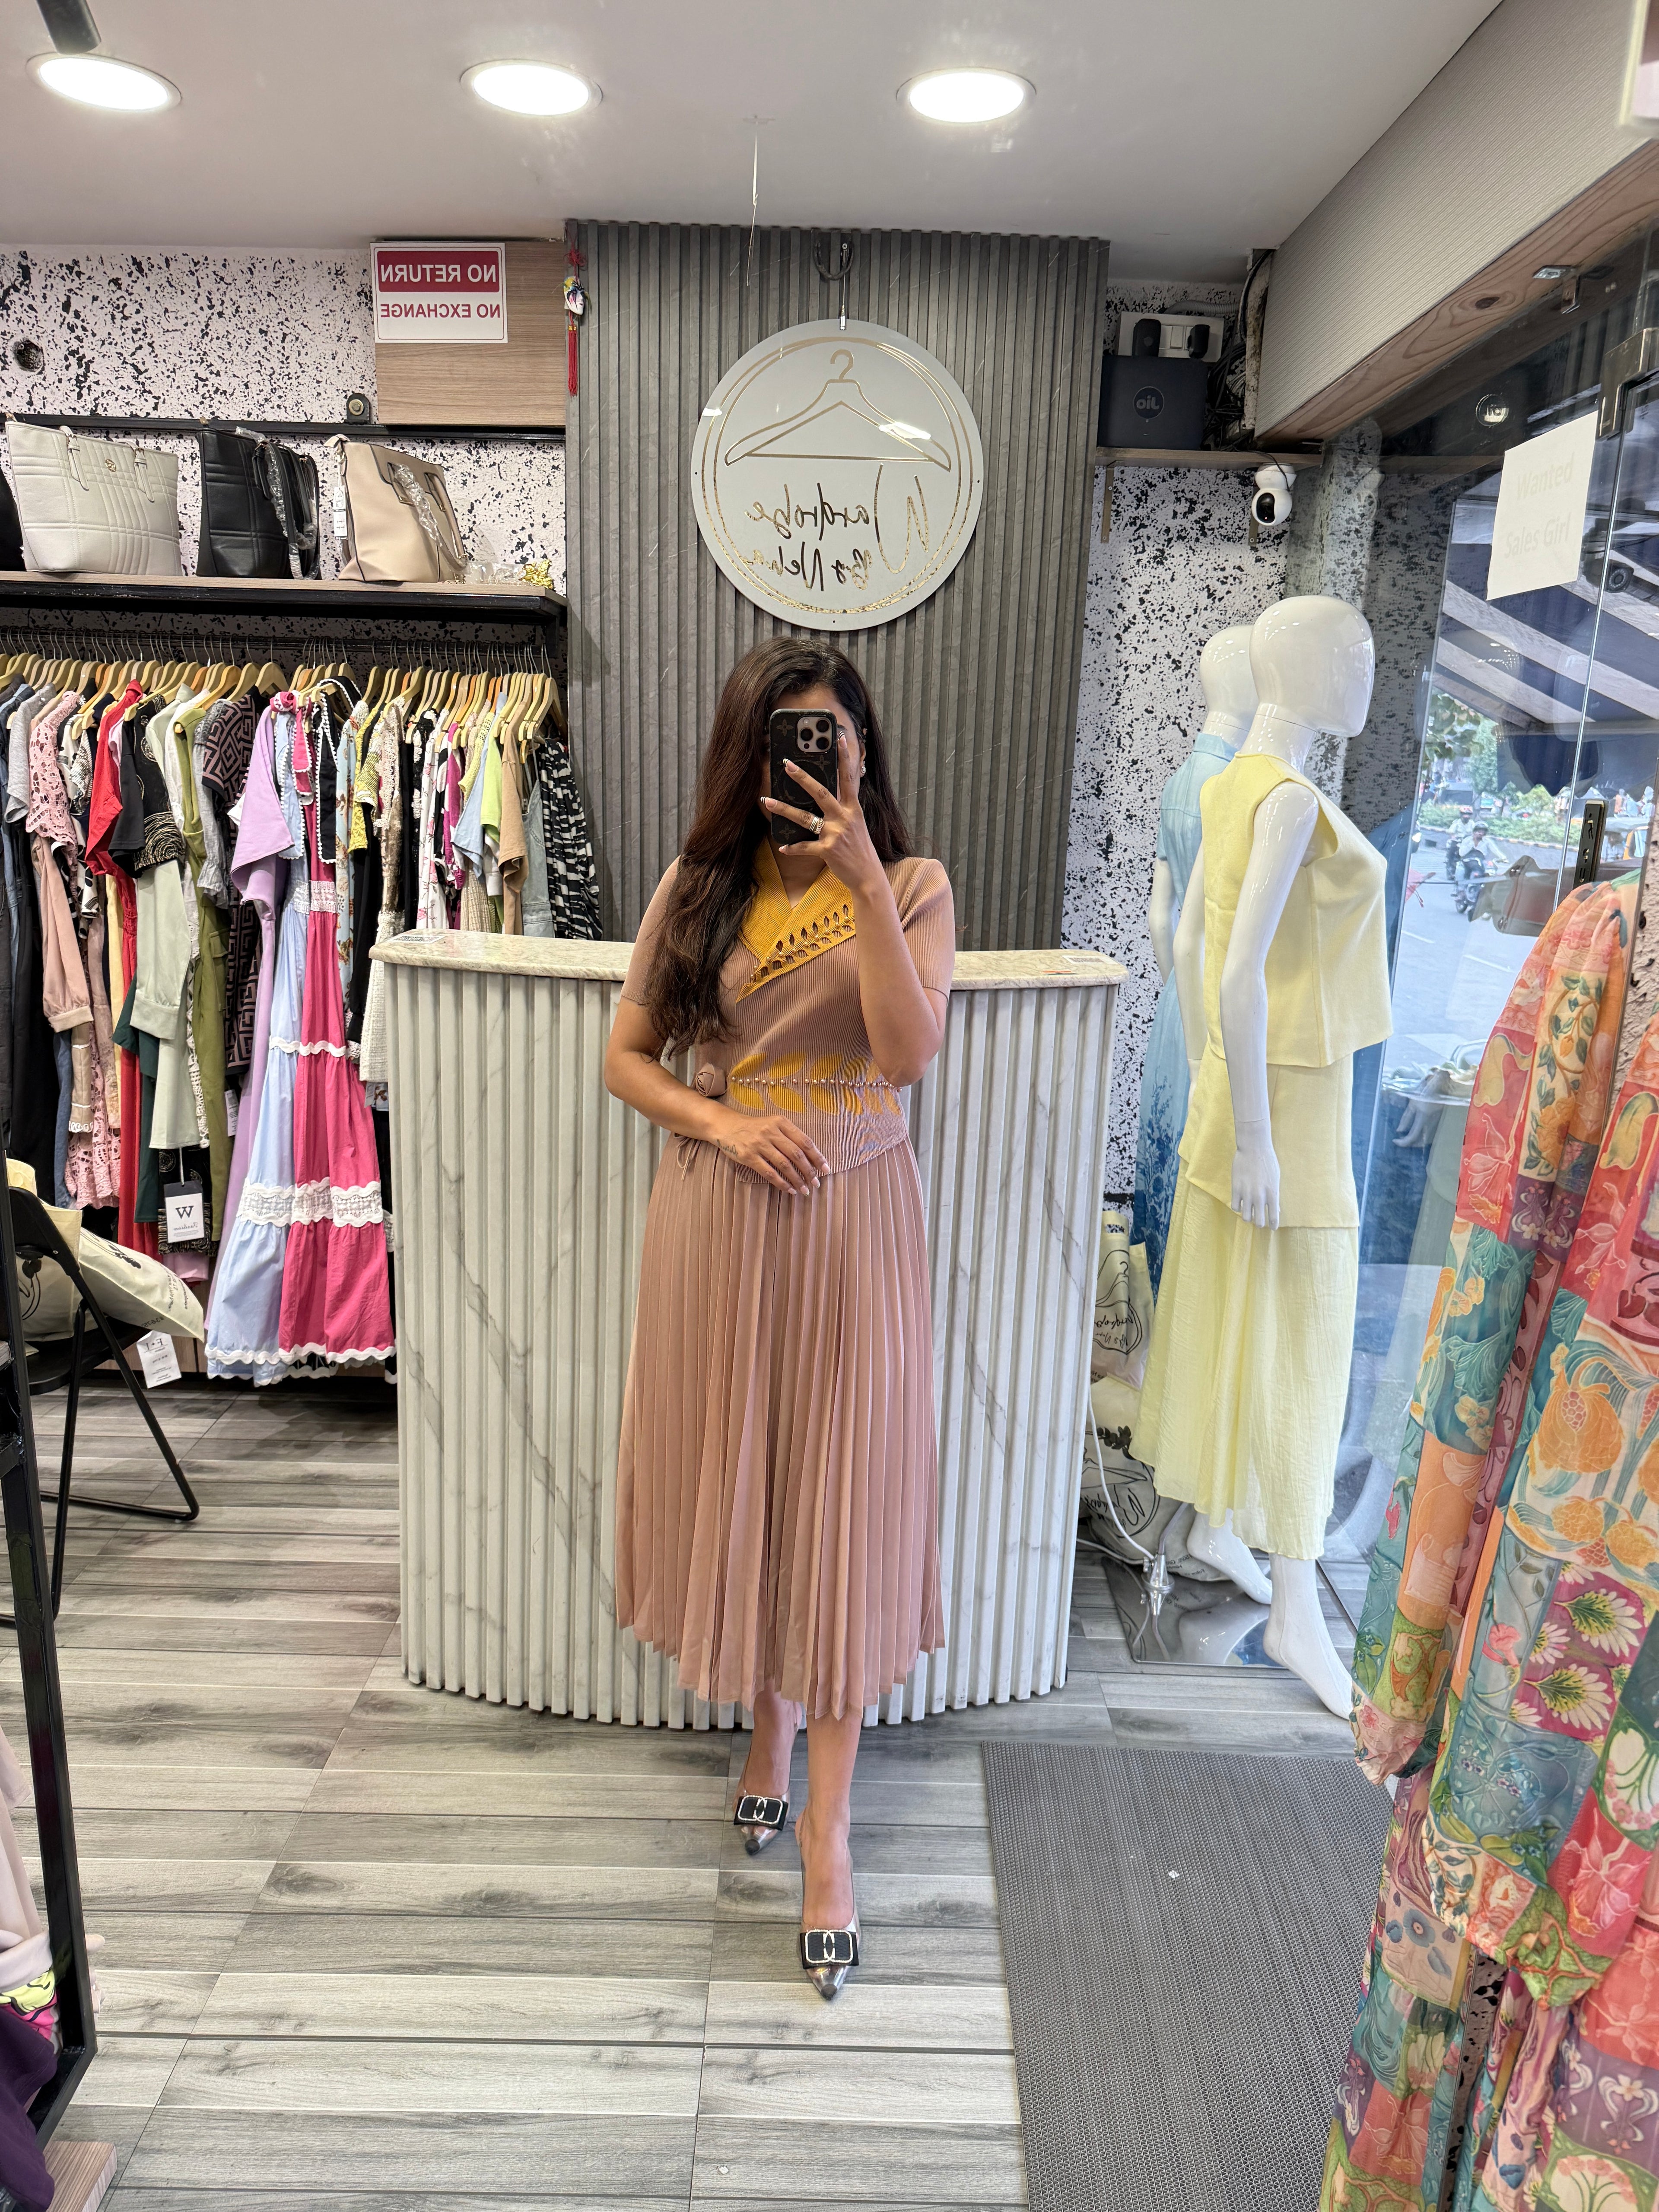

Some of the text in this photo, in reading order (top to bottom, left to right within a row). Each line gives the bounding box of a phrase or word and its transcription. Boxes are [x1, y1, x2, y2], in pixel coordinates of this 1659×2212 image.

[1517, 451, 1575, 501] Wanted
[1504, 512, 1571, 559] Sales Girl
